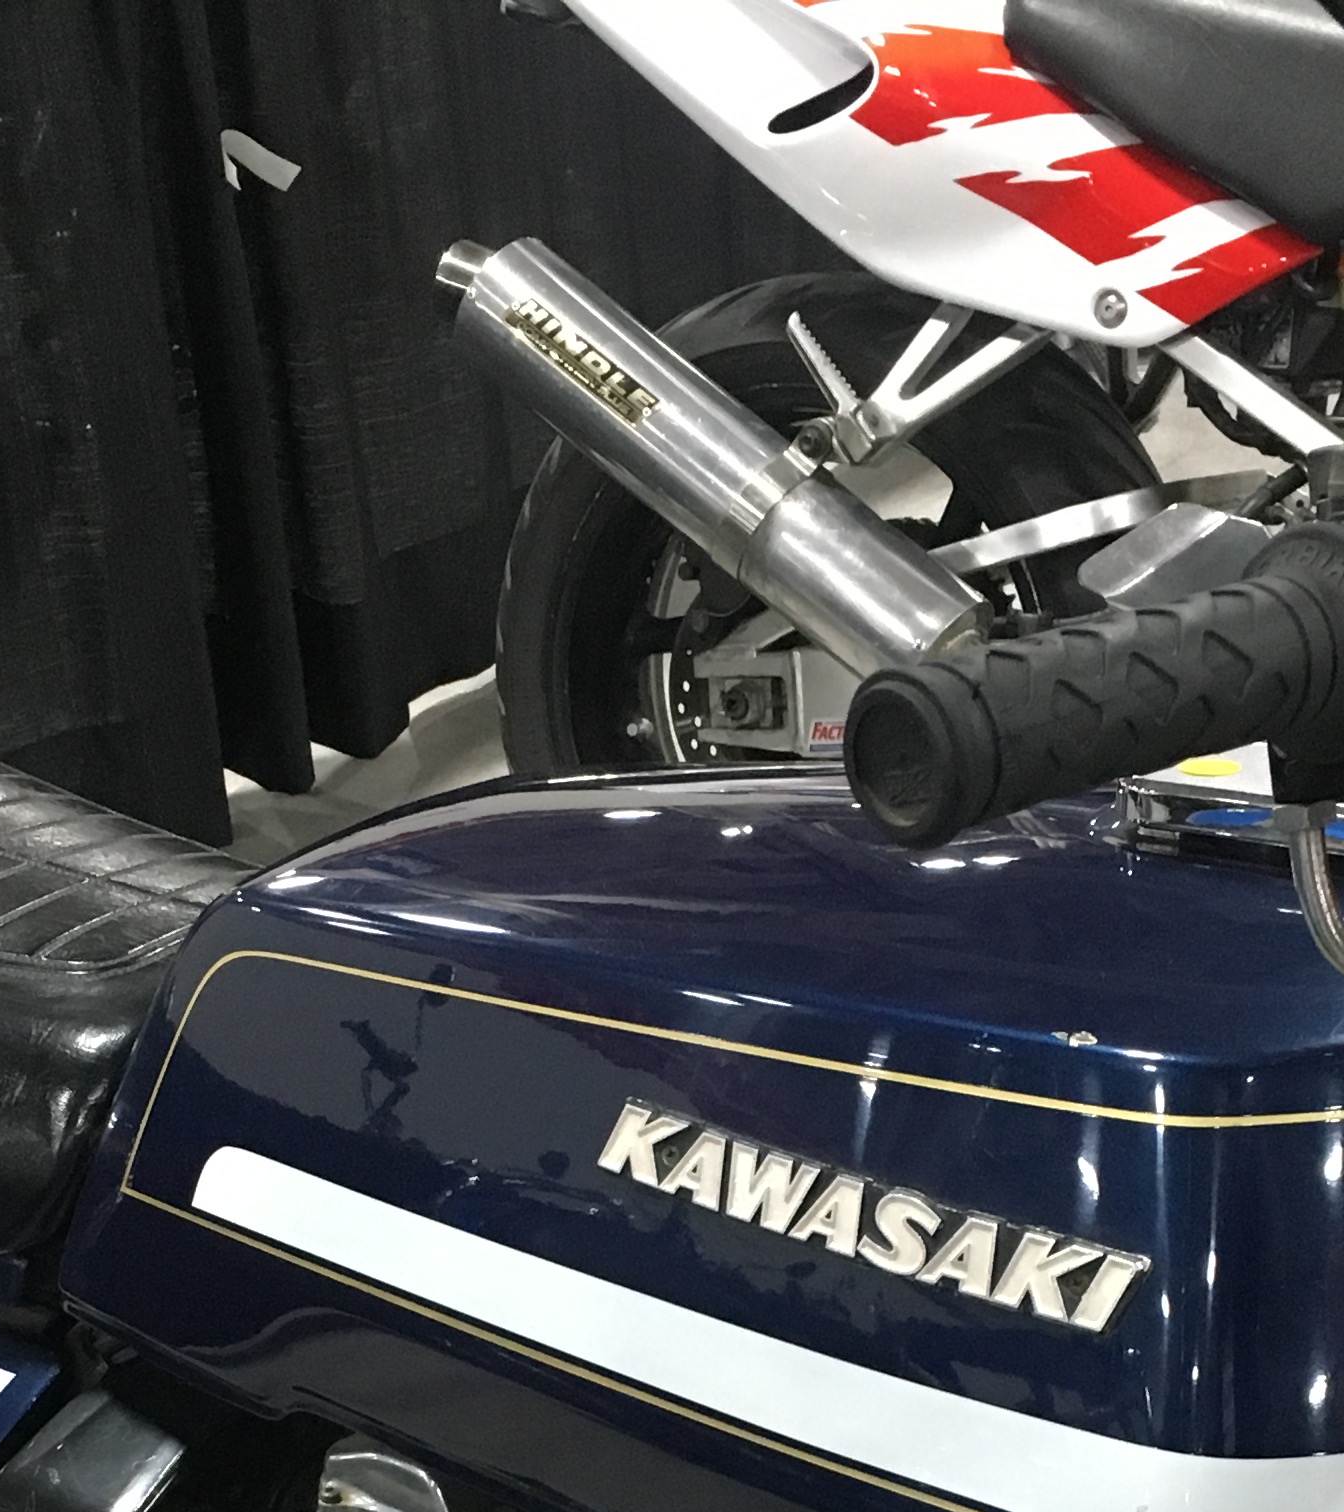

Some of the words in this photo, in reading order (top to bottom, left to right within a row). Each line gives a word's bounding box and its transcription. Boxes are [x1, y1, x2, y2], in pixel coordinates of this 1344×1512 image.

[519, 299, 657, 408] HINDLE
[811, 721, 844, 740] FACT
[597, 1101, 1142, 1333] KAWASAKI
